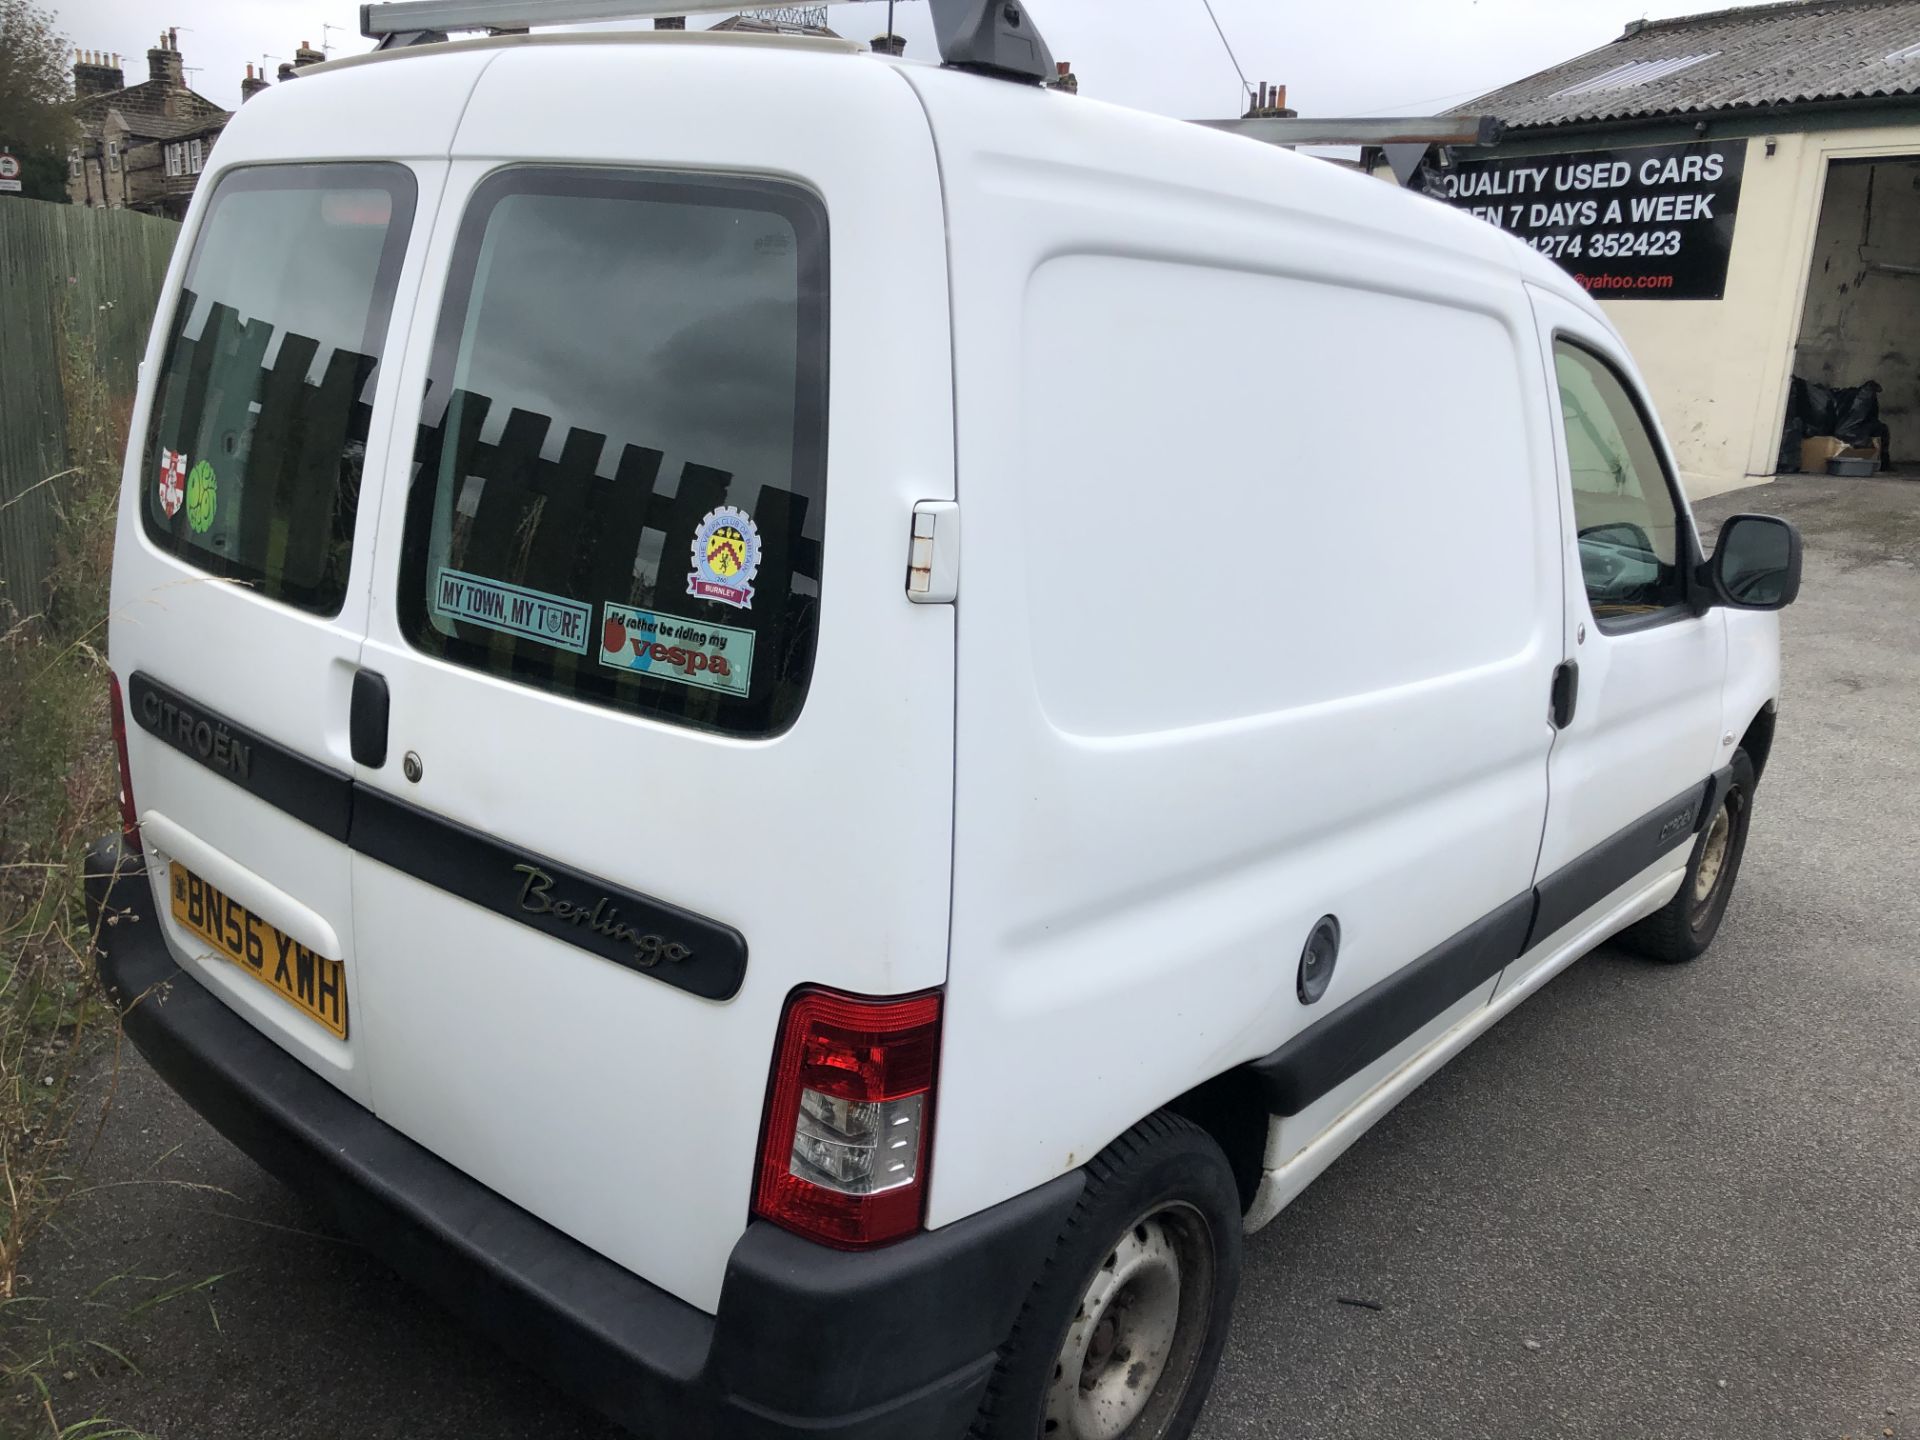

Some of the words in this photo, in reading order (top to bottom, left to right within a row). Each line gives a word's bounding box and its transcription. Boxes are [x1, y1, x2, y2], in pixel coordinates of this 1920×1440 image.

[1443, 168, 1549, 198] QUALITY
[1555, 162, 1631, 191] USED
[1639, 154, 1724, 185] CARS
[1510, 205, 1524, 228] 7
[1529, 201, 1597, 227] DAYS
[1603, 200, 1622, 224] A
[1630, 194, 1716, 222] WEEK
[1519, 234, 1582, 258] 1274
[1588, 231, 1681, 257] 352423
[721, 518, 740, 528] CLUB
[443, 581, 463, 607] MY
[467, 586, 507, 623] TOWN,
[511, 598, 534, 626] MY
[704, 585, 735, 598] BURNLEY
[611, 612, 626, 626] I'd
[626, 618, 658, 633] rather
[659, 622, 672, 637] be
[675, 626, 706, 647] riding
[709, 635, 728, 651] my
[630, 637, 731, 676] vespa
[143, 691, 249, 779] CITROËN
[512, 863, 694, 967] Berlingo
[187, 869, 263, 969] BN56
[273, 928, 339, 1025] XWH
